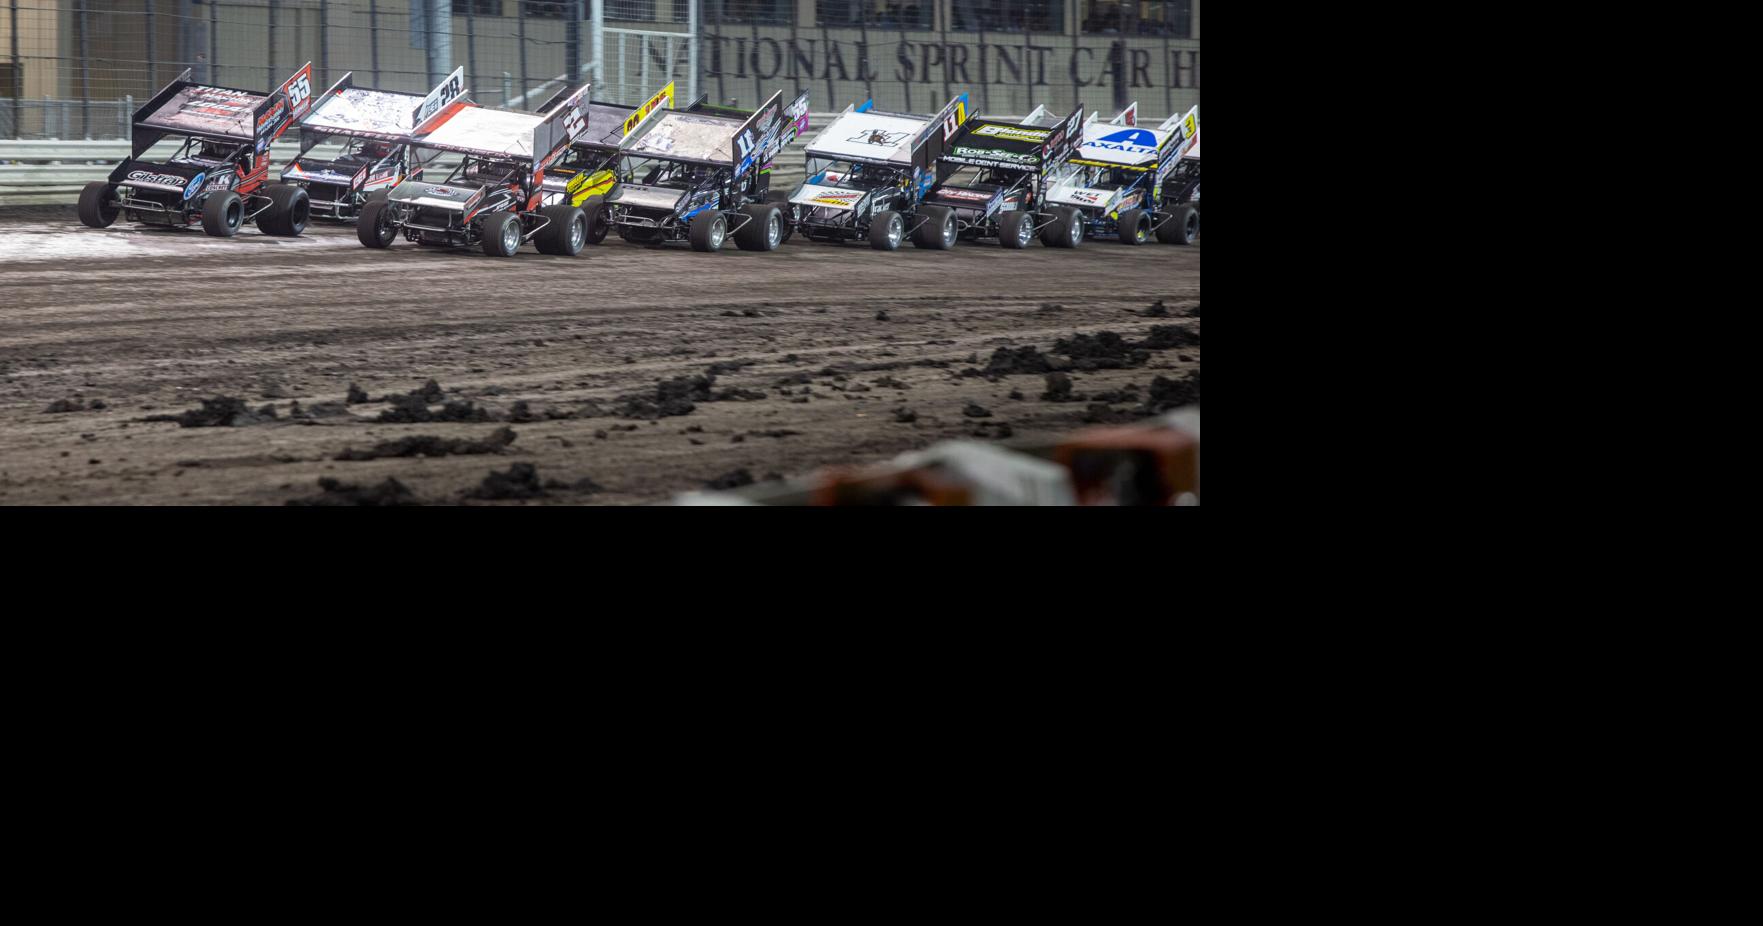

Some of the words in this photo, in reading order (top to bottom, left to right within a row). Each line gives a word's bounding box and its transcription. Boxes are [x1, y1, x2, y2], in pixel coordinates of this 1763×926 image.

[895, 42, 1053, 86] SPRINT
[1070, 46, 1153, 88] CAR
[287, 73, 311, 107] 55
[440, 76, 460, 106] 28
[563, 107, 586, 140] 2
[1185, 113, 1197, 139] 3
[942, 155, 975, 165] MOBILE
[975, 159, 998, 168] DENT
[1082, 141, 1158, 155] AXALTA
[128, 170, 188, 187] Gilstrap
